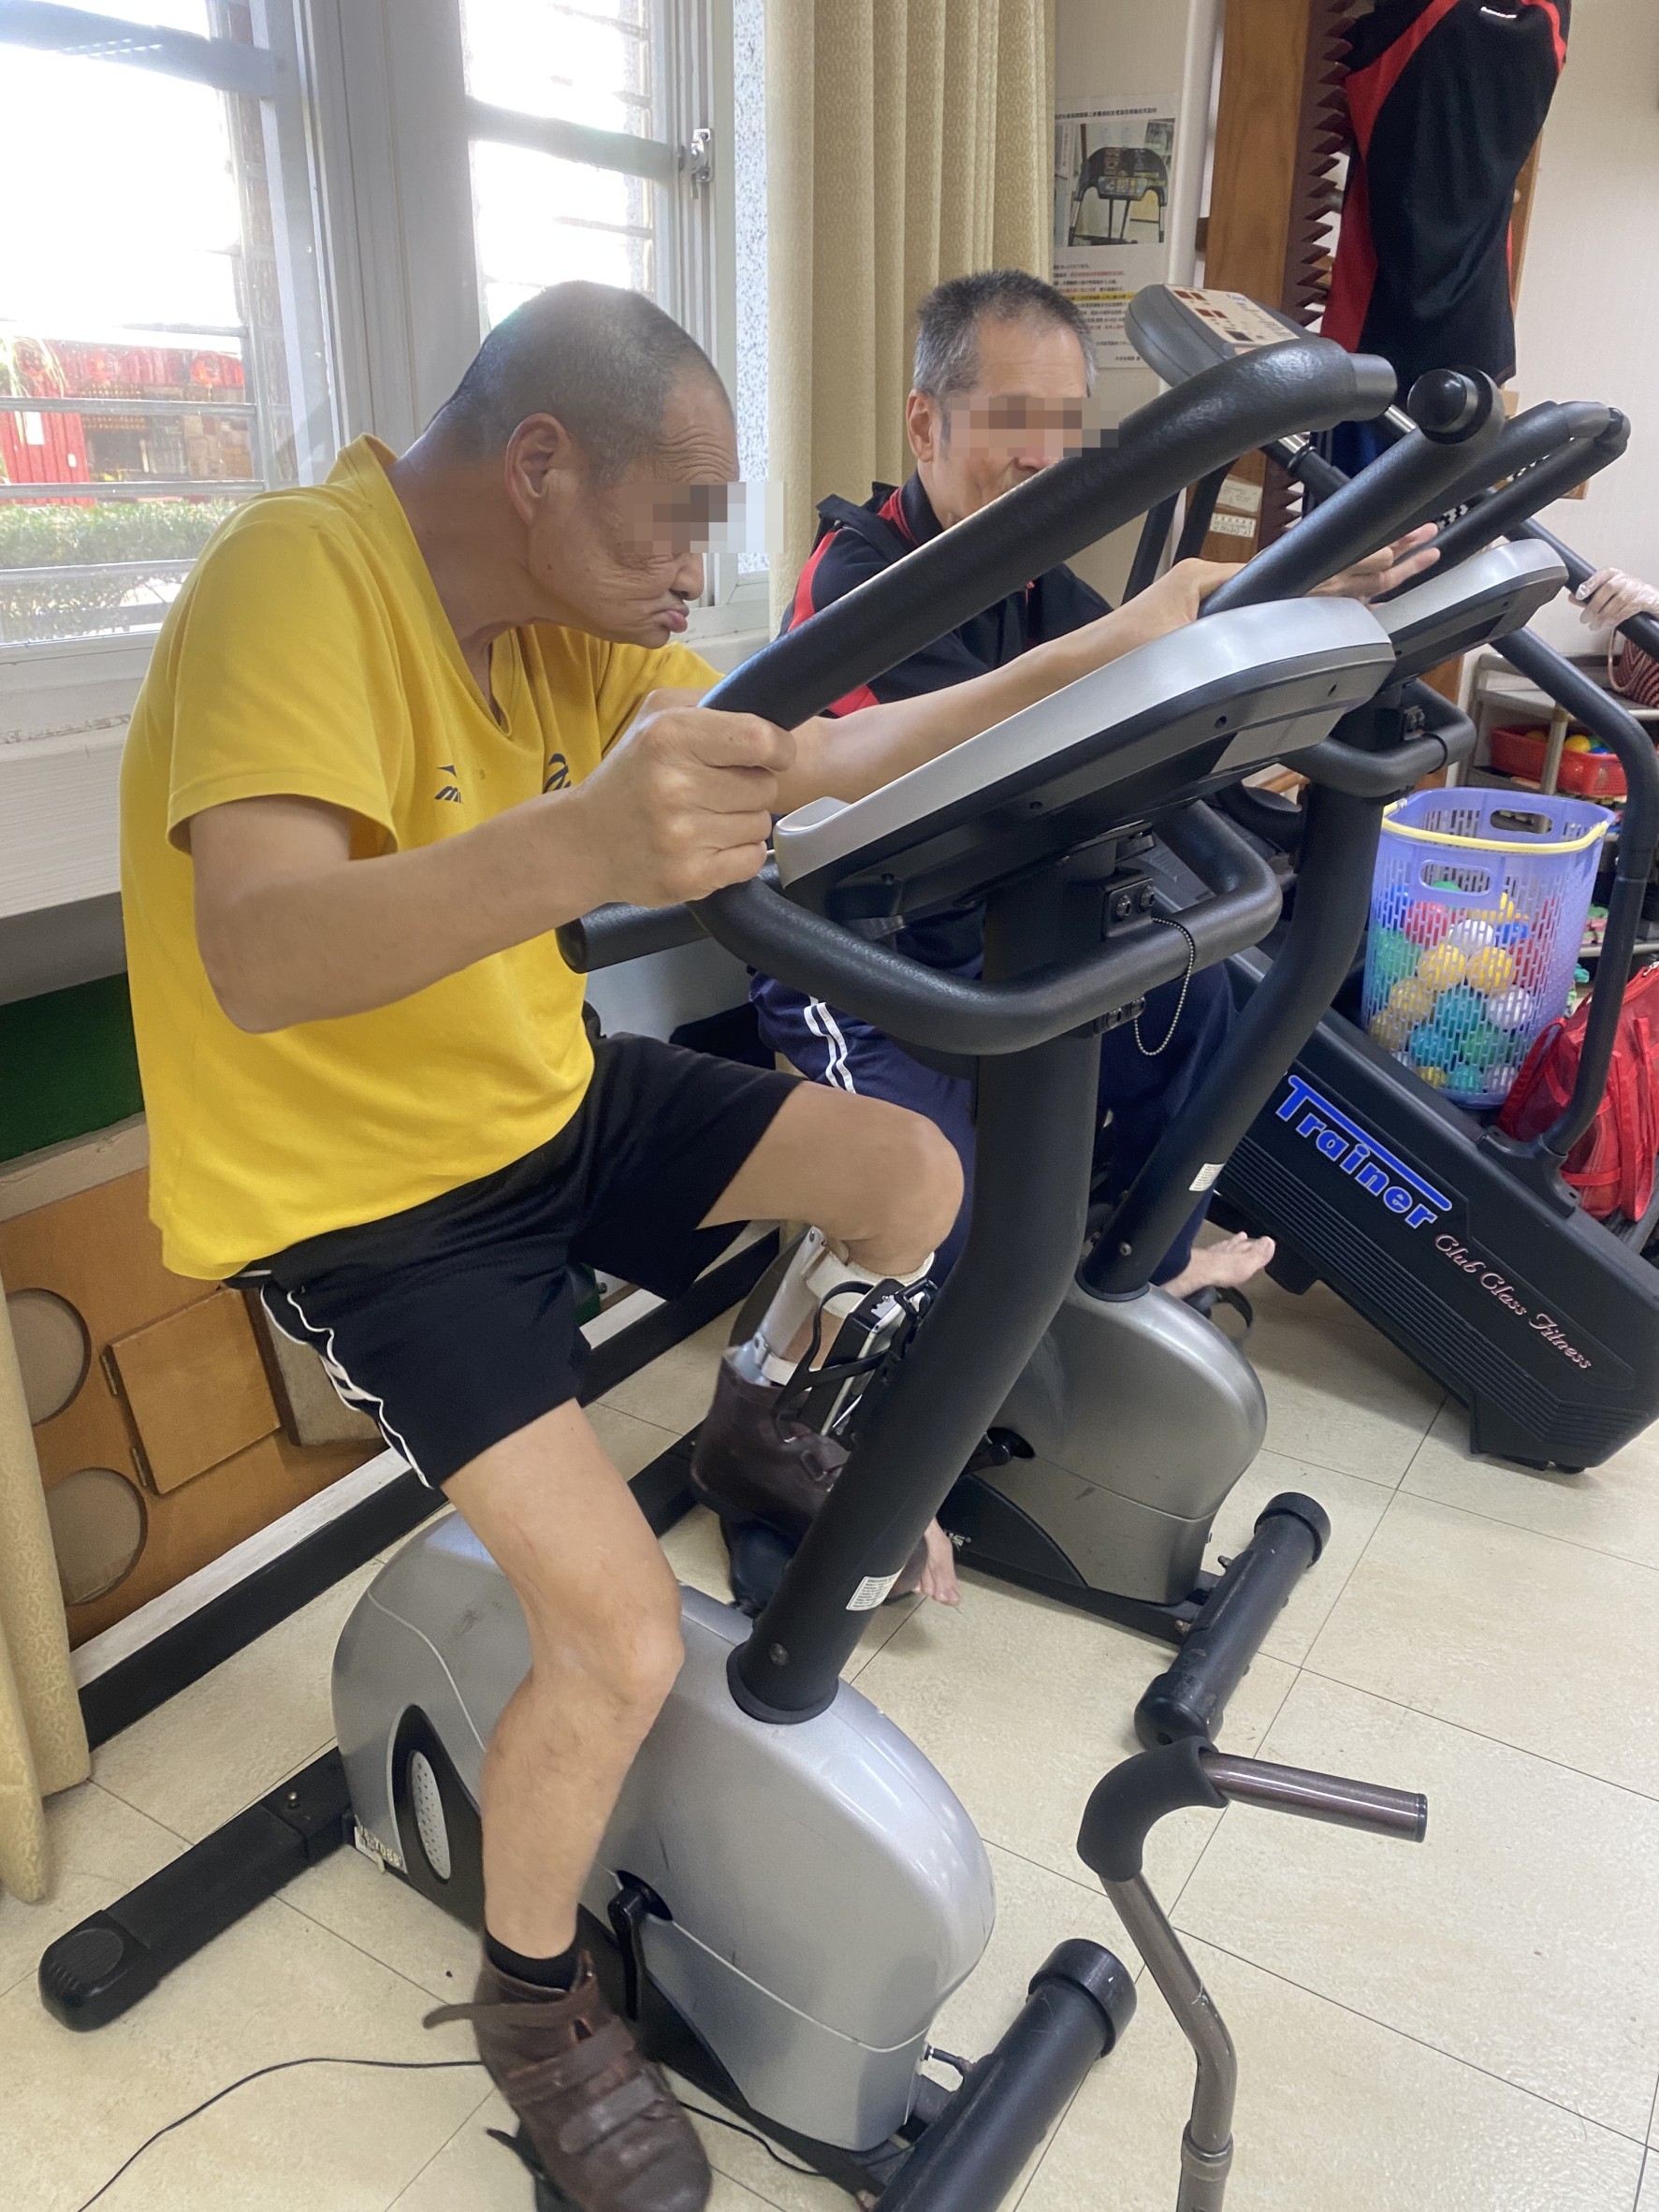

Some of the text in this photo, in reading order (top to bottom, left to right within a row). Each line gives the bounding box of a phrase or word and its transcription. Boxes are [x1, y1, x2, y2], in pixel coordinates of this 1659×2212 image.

[1275, 1075, 1452, 1229] Trainer
[1434, 1233, 1592, 1369] Club Class Fitness
